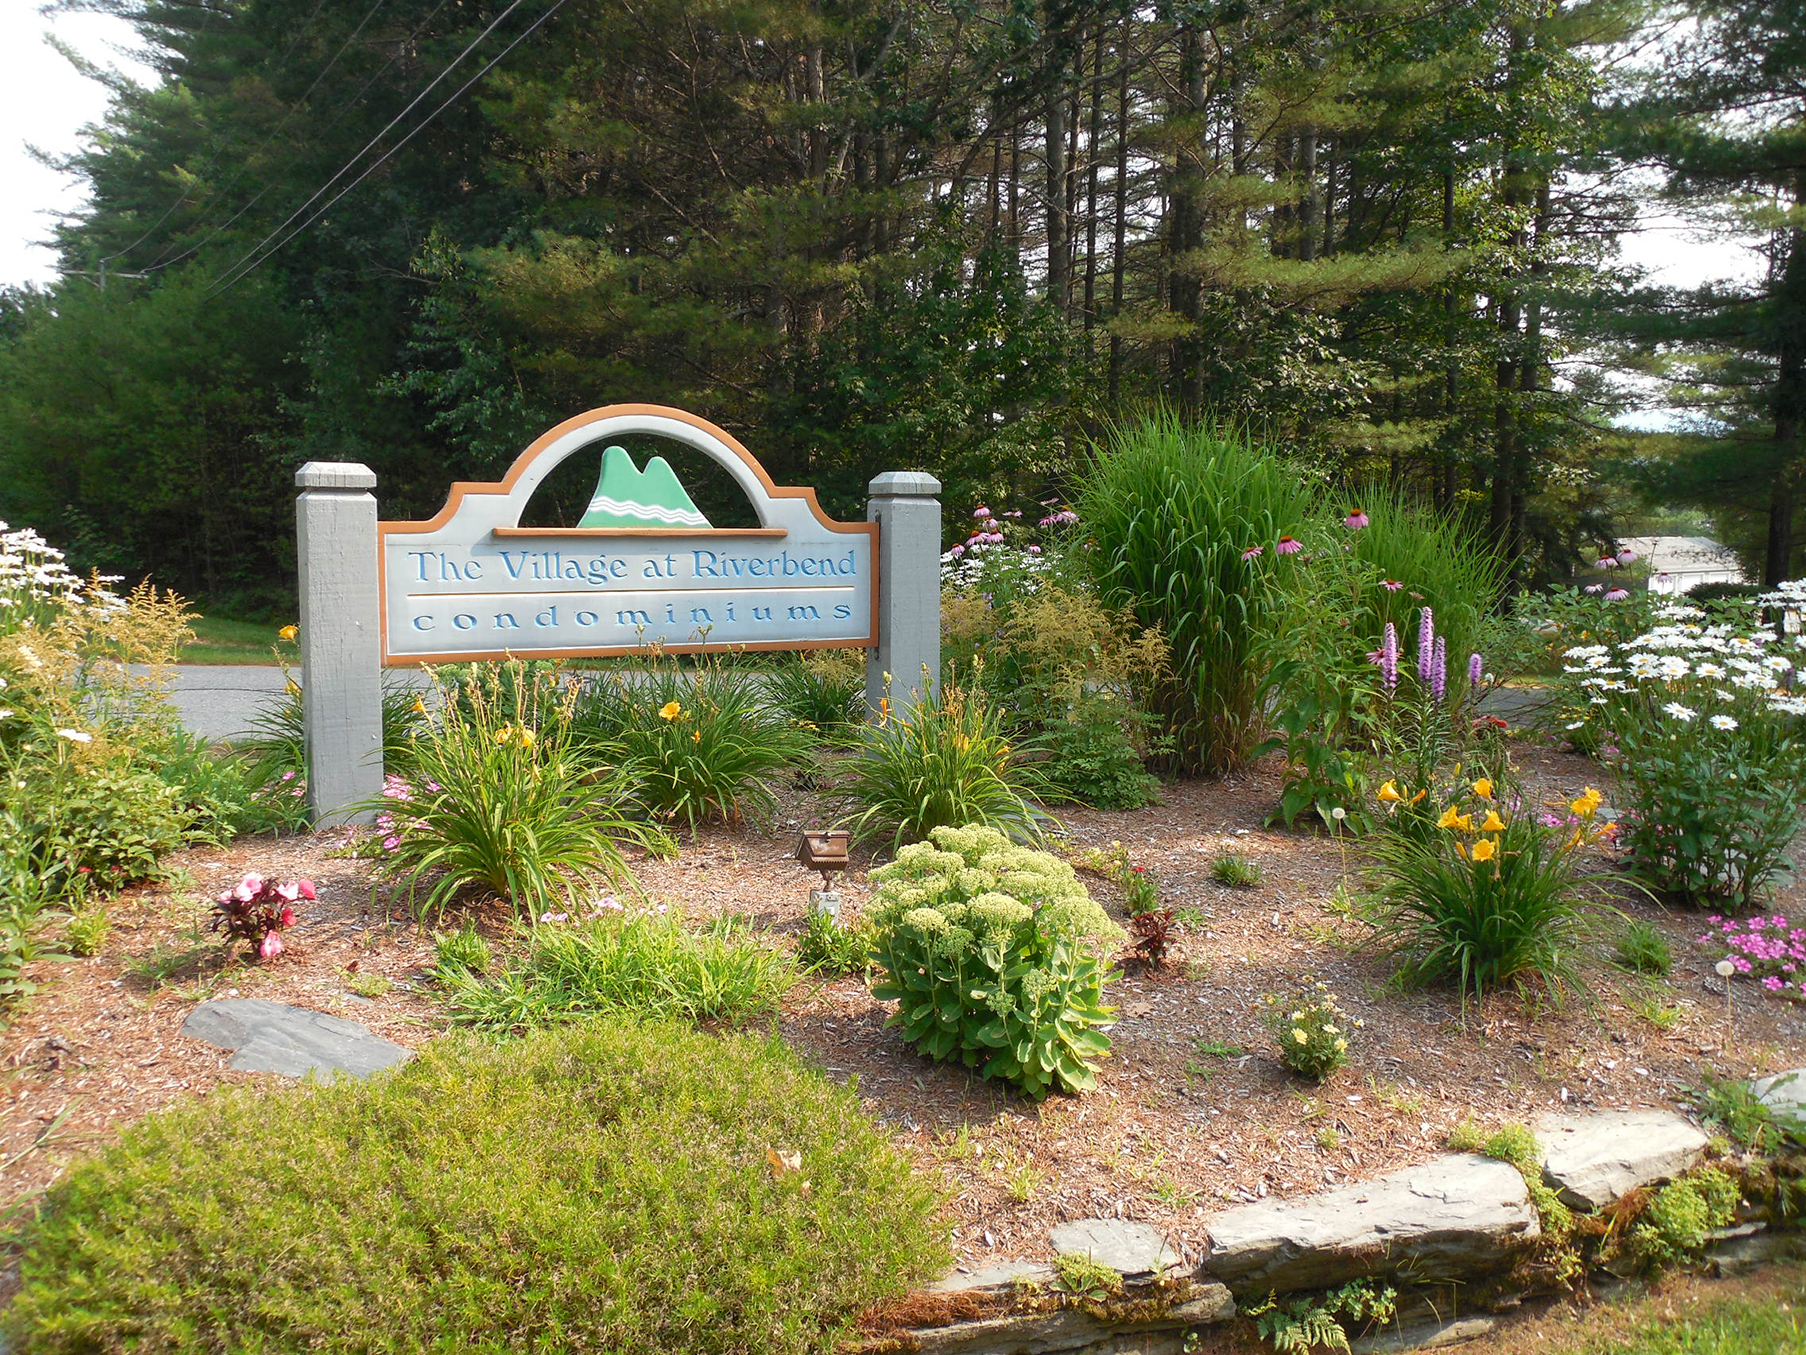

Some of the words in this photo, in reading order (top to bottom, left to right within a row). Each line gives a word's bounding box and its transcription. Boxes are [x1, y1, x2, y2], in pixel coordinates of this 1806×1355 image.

[408, 551, 483, 582] The
[499, 551, 628, 585] Village
[643, 553, 677, 578] at
[692, 550, 856, 578] Riverbend
[412, 602, 852, 631] condominiums
